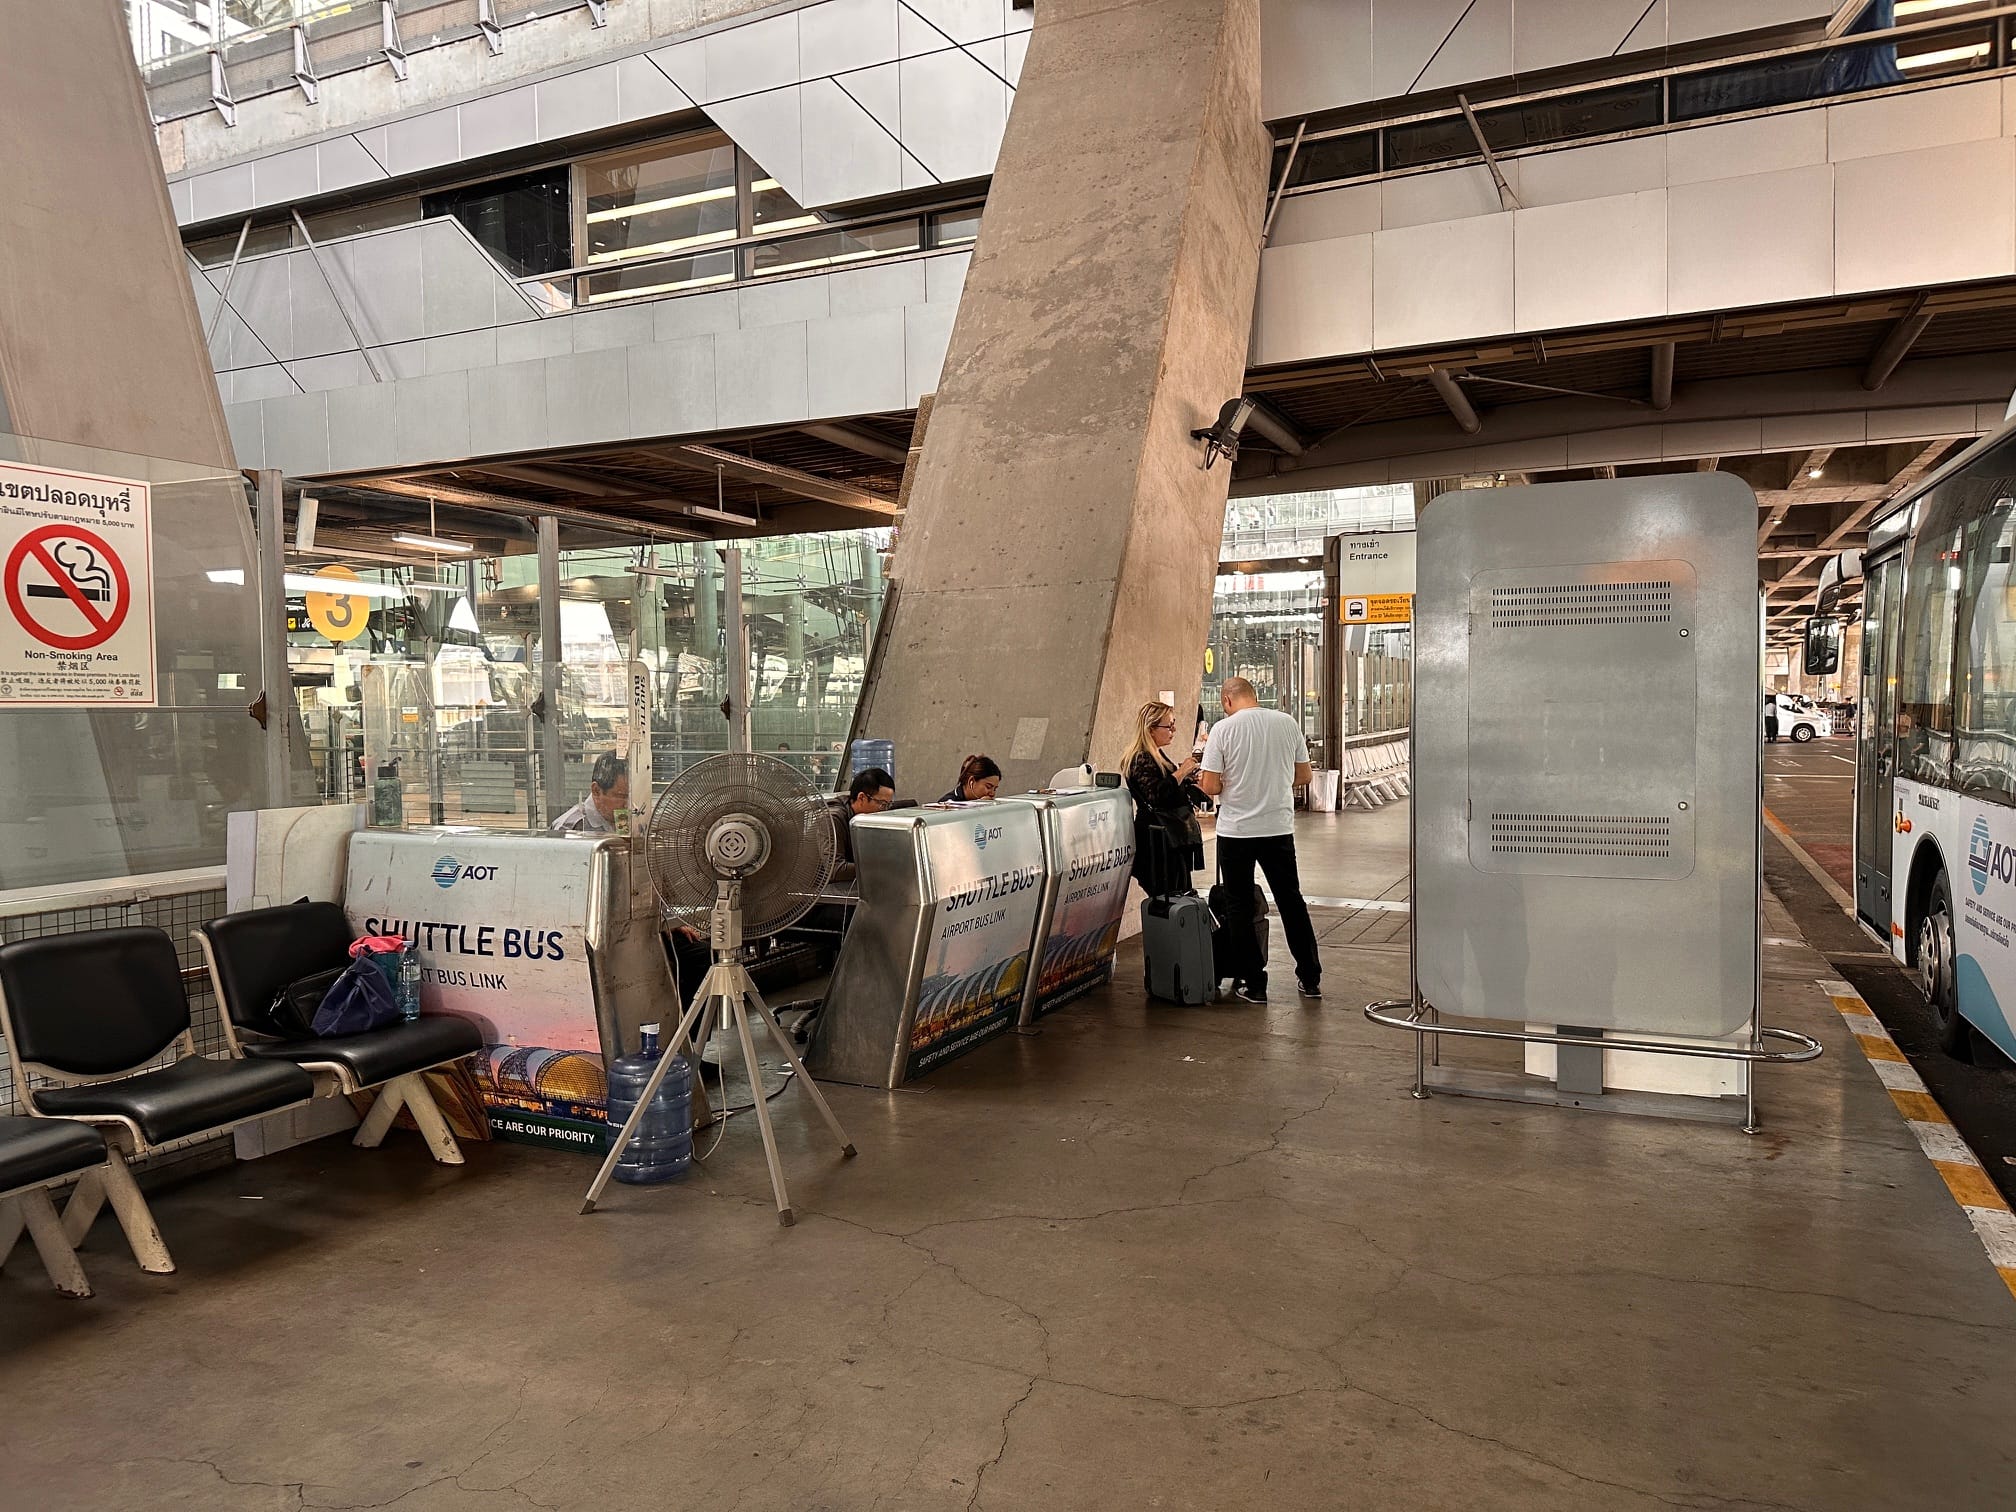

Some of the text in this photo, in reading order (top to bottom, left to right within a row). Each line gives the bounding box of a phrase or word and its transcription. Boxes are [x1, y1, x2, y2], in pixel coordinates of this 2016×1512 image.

[102, 518, 120, 528] 5,000
[1350, 552, 1388, 560] Entrance
[326, 592, 352, 628] 3
[24, 650, 118, 662] Non-Smoking Area
[988, 826, 1002, 840] AOT
[462, 866, 498, 880] AOT
[1069, 845, 1131, 881] SHUTTLE BUS
[946, 865, 1034, 912] SHUTTLE BUS
[941, 908, 1006, 940] AIRPORT BUS LINK
[365, 918, 564, 961] SHUTTLE BUS
[438, 970, 466, 986] BUS
[470, 972, 508, 990] LINK
[505, 1121, 524, 1133] ARE
[526, 1124, 547, 1137] OUR
[548, 1128, 595, 1144] PRIORITY
